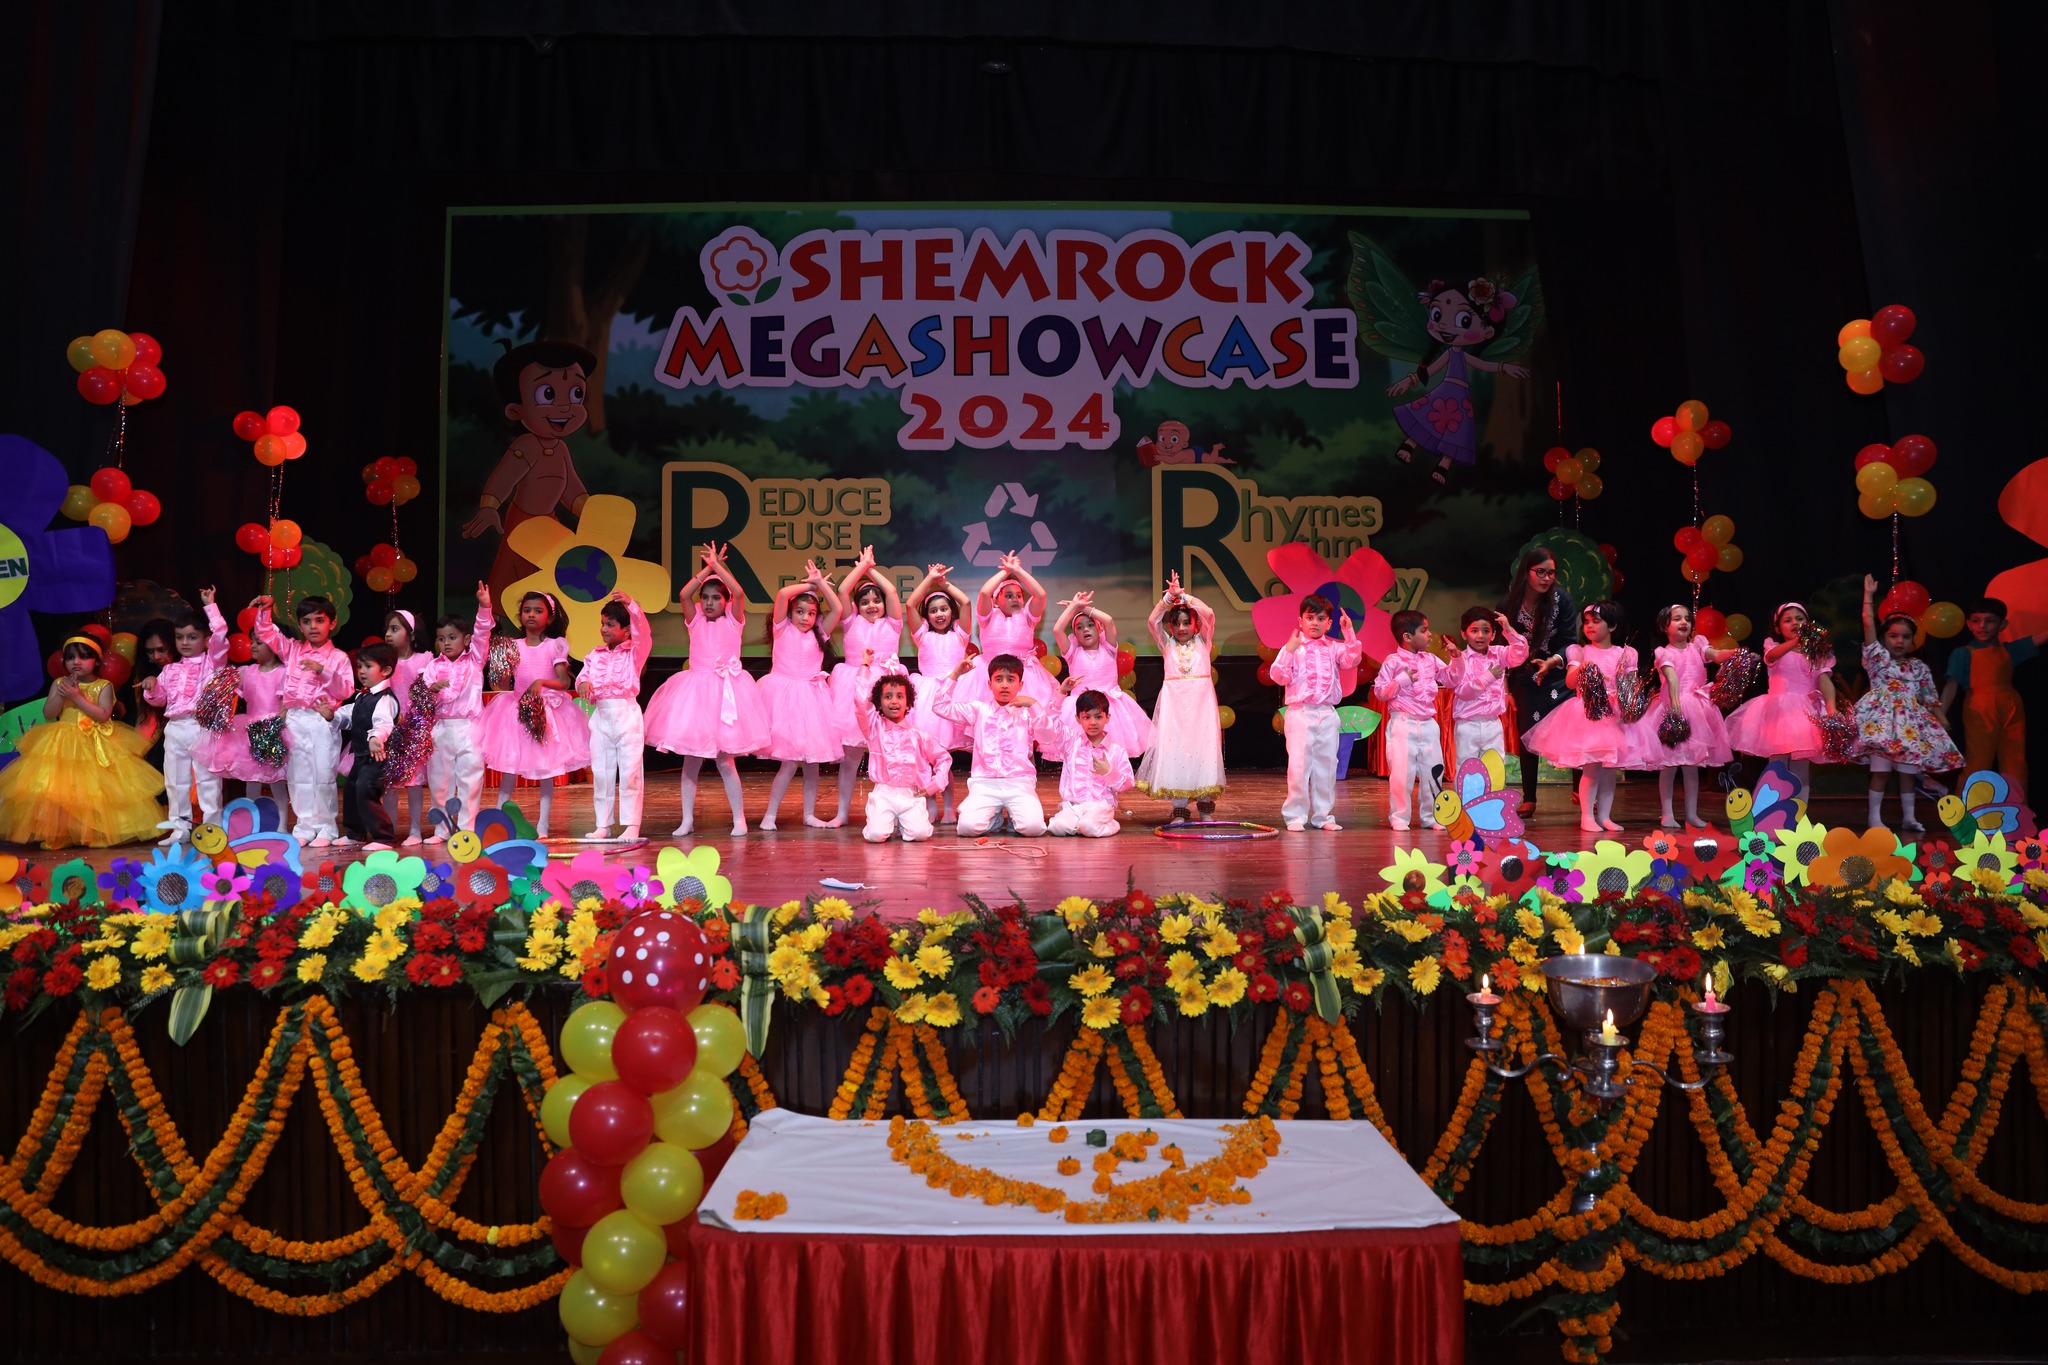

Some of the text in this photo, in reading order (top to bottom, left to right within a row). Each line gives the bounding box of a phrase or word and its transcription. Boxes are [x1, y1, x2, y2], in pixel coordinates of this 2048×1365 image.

[790, 238, 1304, 304] SHEMROCK
[664, 313, 1351, 380] MEGASHOWCASE
[907, 392, 1111, 440] 2024
